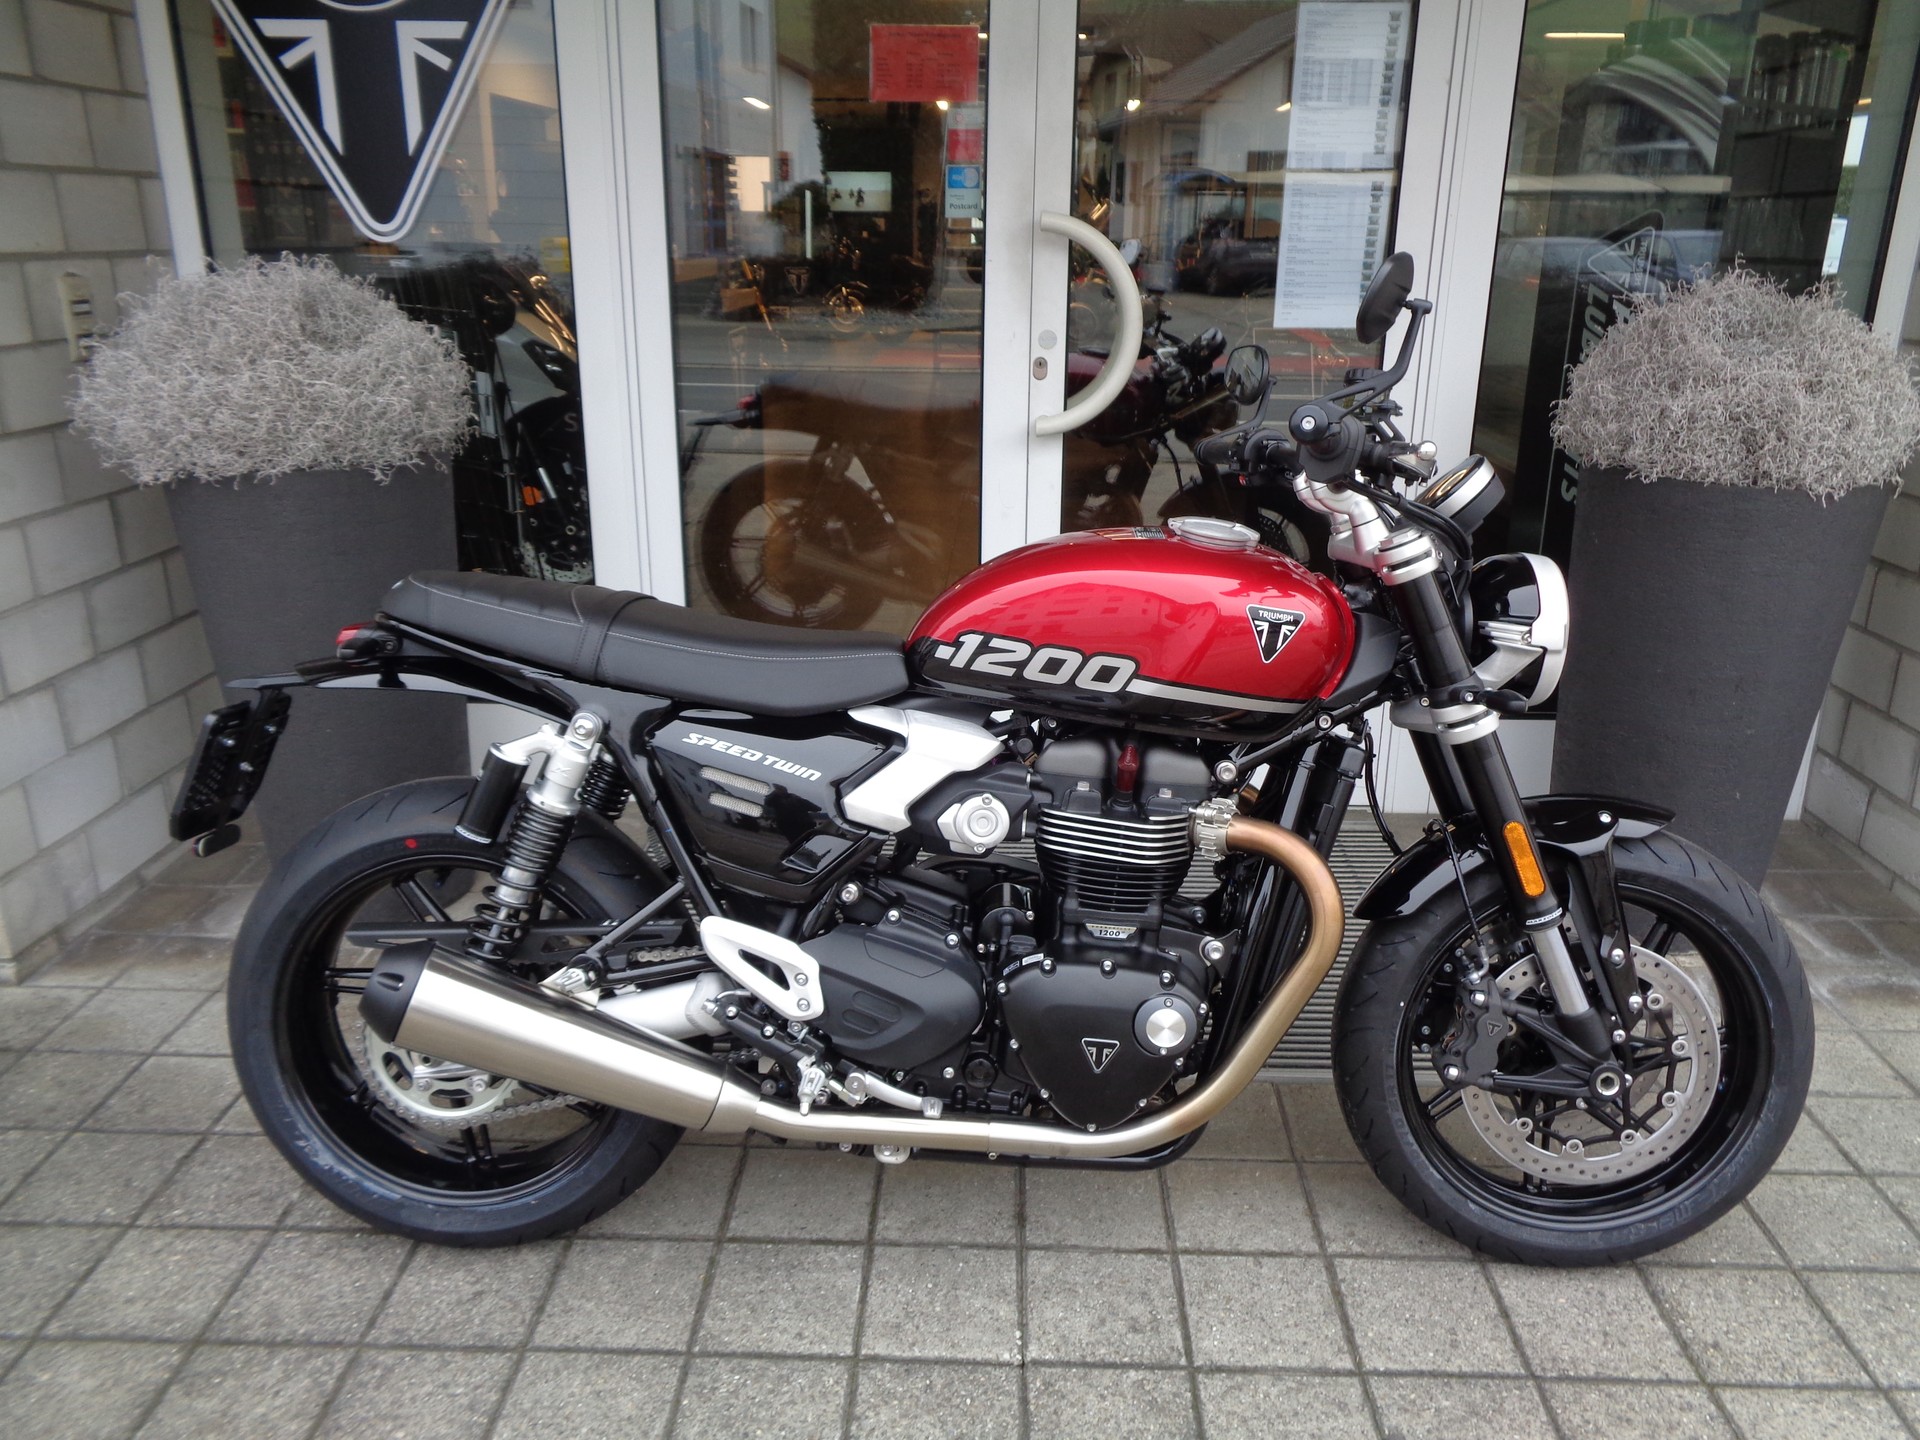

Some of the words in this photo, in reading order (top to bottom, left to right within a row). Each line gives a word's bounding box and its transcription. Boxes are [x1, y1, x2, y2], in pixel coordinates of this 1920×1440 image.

[1258, 609, 1294, 622] TRIUMPH
[949, 633, 1137, 693] 1200
[681, 733, 764, 762] SPEED
[762, 755, 822, 782] TWIN
[1098, 929, 1121, 937] 1200
